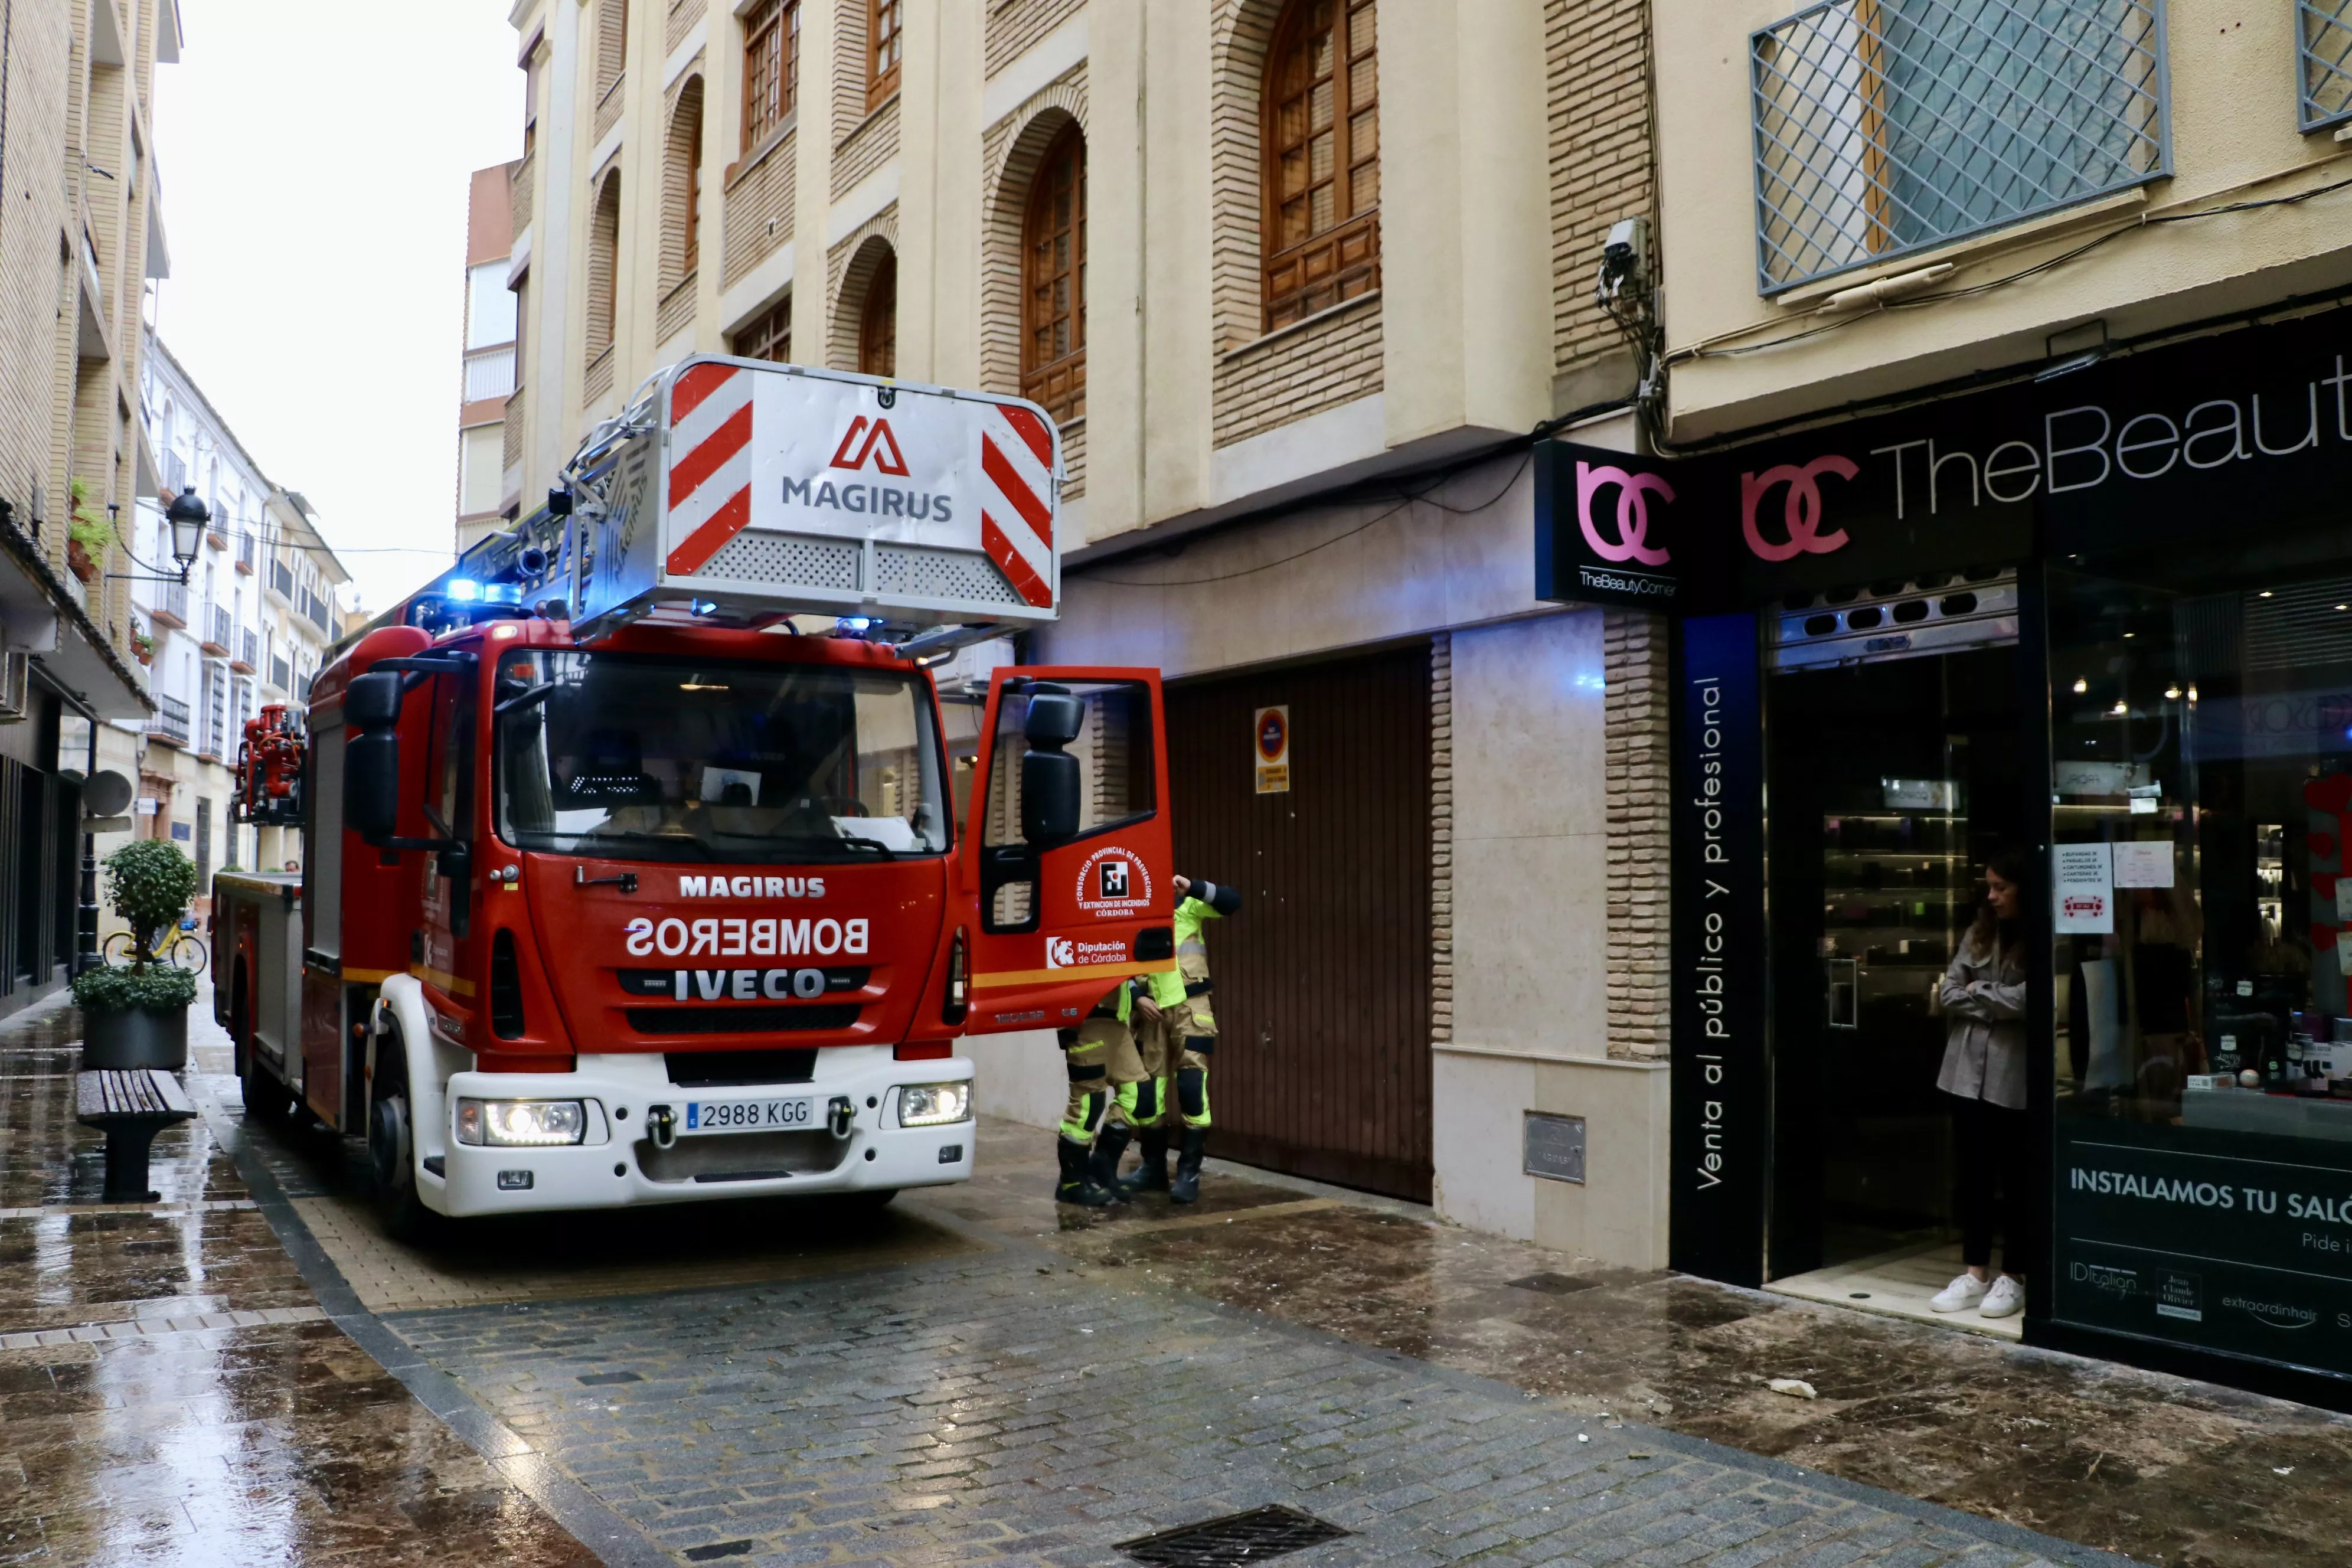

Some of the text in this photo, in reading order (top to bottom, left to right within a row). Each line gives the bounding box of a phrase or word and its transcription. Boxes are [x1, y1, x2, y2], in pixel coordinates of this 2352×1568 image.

[782, 476, 952, 522] MAGIRUS
[1579, 571, 1677, 596] TheBeautyCorner
[1077, 846, 1152, 901] CONSORCIO PROVINCIAL DE PREVENCION
[679, 876, 826, 898] MAGIRUS
[1693, 678, 1730, 1191] Venta al público y profesional
[1077, 940, 1126, 954] Diputación
[1078, 952, 1126, 963] de Córdoba
[674, 968, 825, 1001] IVECO
[703, 1102, 807, 1126] 2988 KGG
[2070, 1167, 2234, 1209] INSTALAMOS
[2242, 1187, 2277, 1214] TU
[2302, 1233, 2340, 1252] Pide
[2162, 1284, 2194, 1296] Claude
[2168, 1275, 2188, 1285] Jean
[2163, 1293, 2195, 1306] Olivier
[2222, 1296, 2319, 1321] extraordinhair
